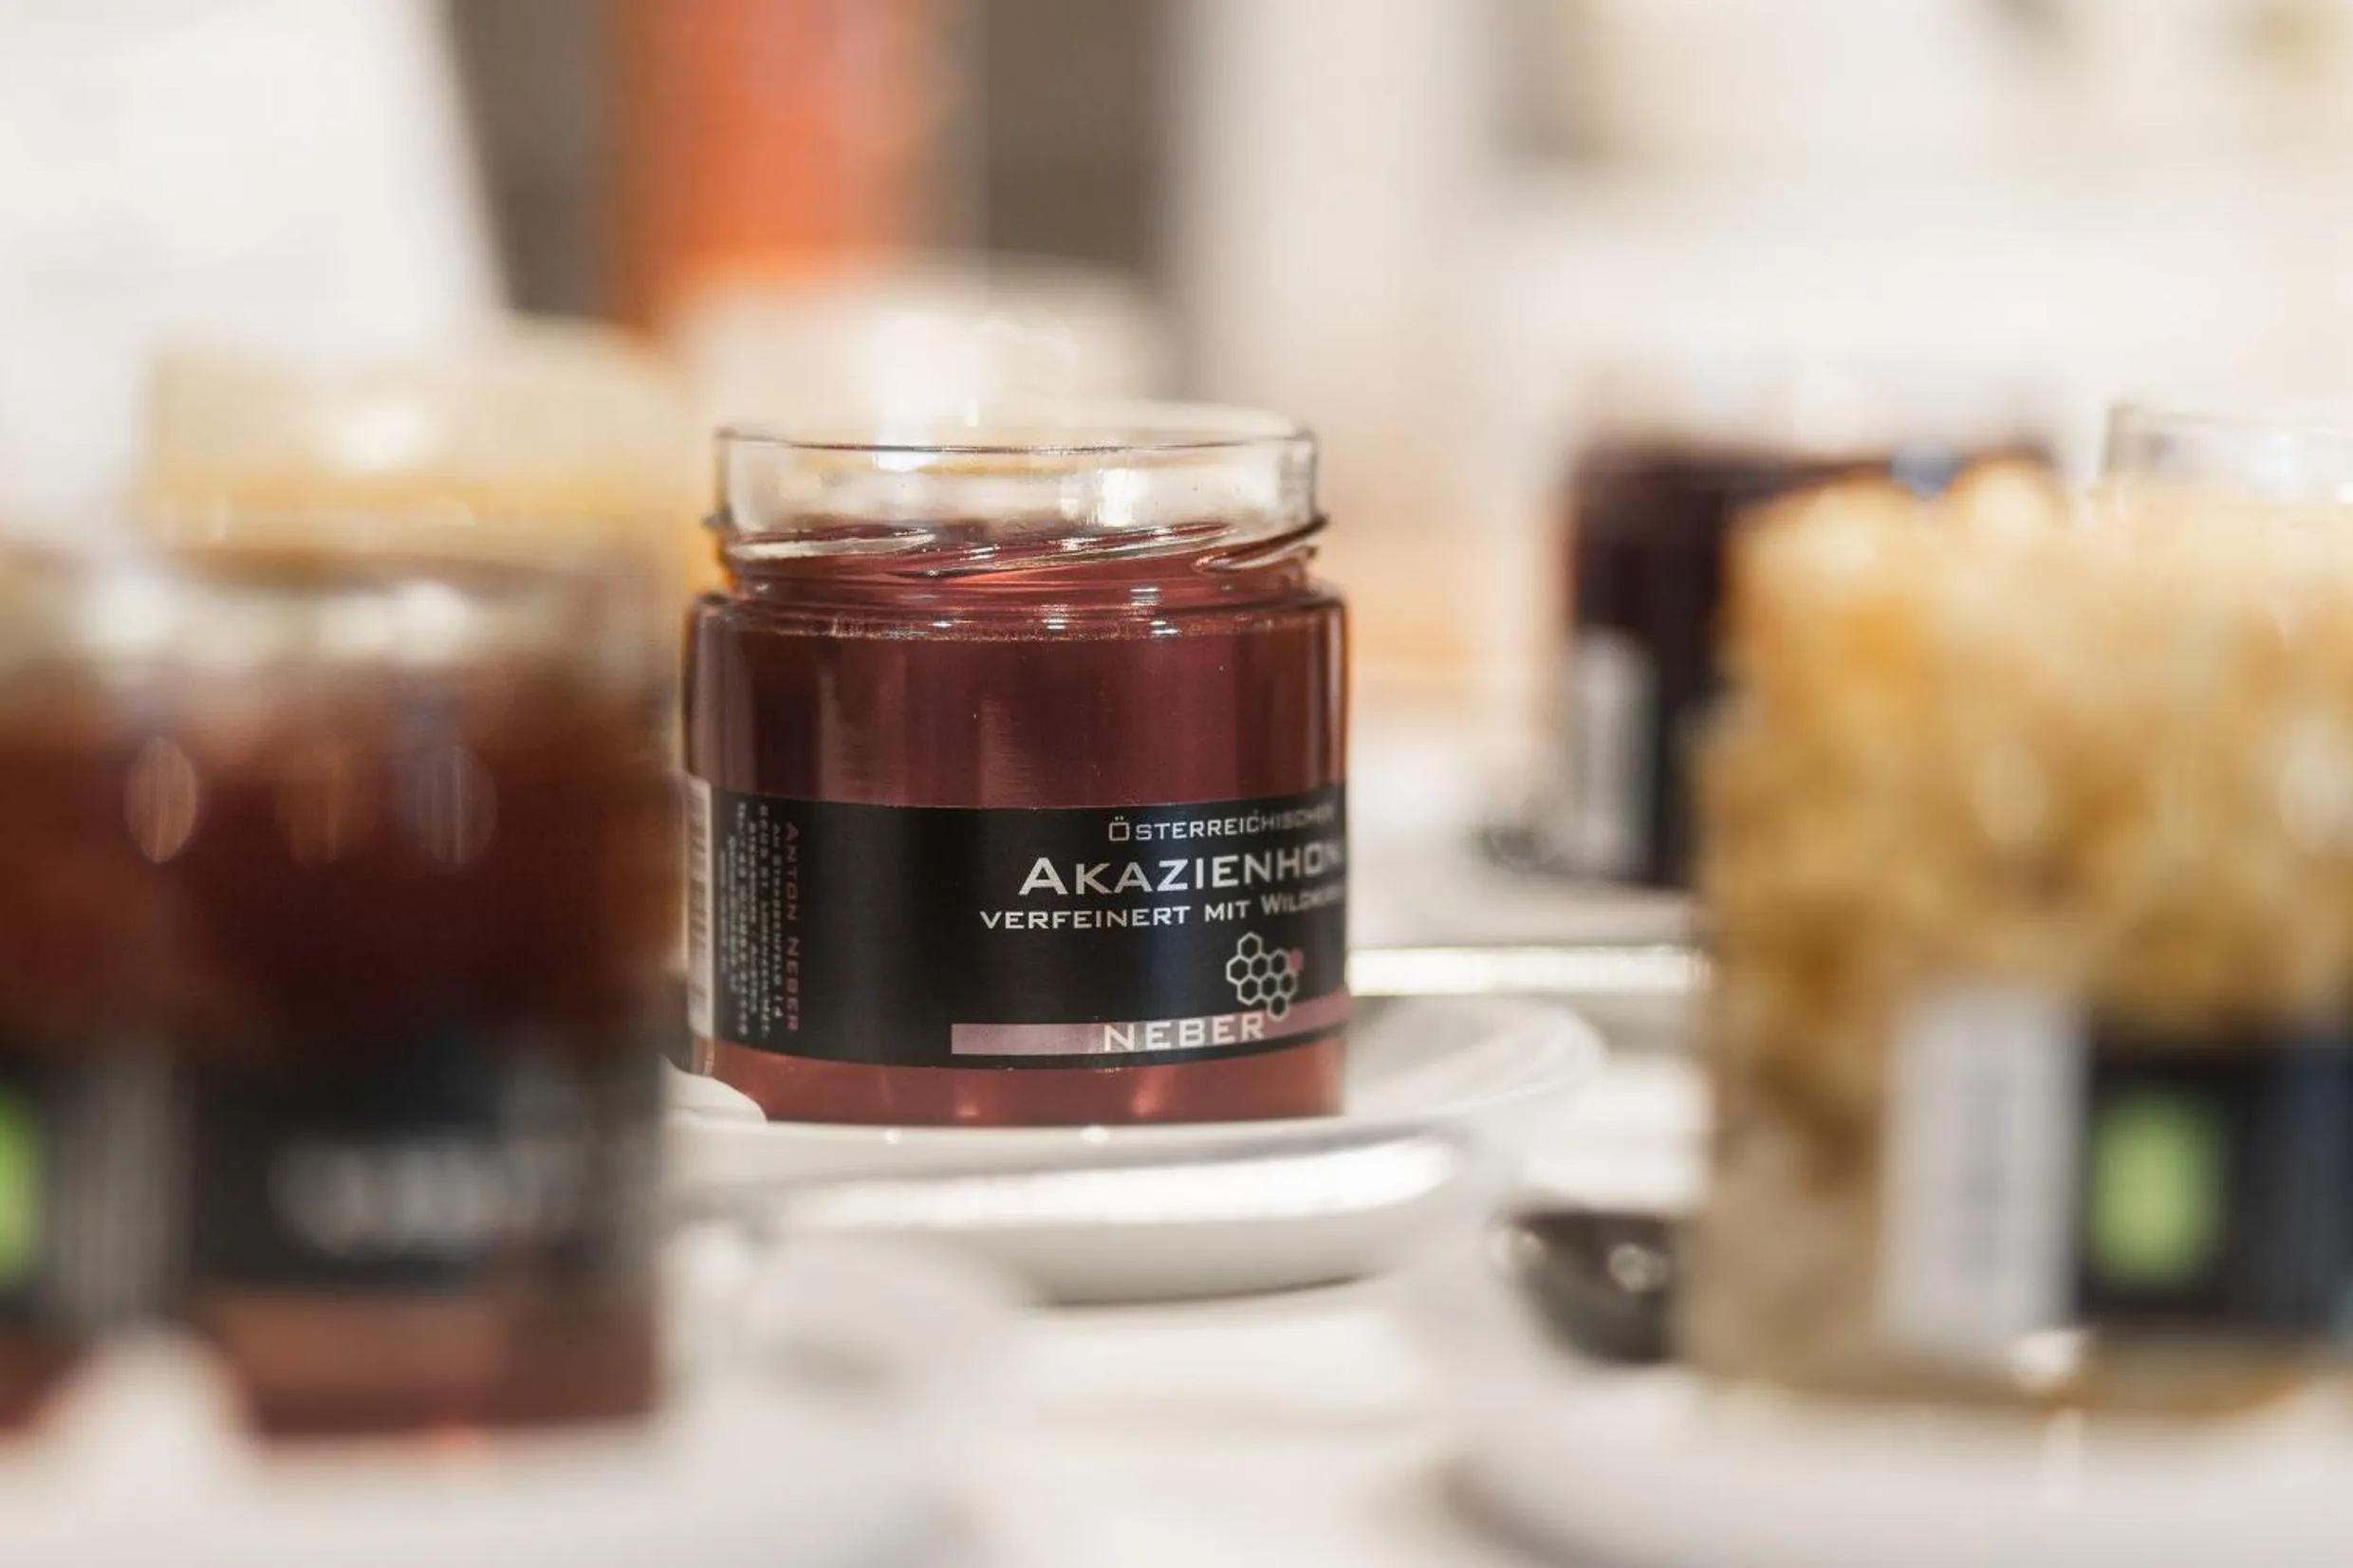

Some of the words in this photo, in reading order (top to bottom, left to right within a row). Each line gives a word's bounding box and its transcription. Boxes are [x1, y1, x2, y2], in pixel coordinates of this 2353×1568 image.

[979, 905, 1192, 930] VERFEINERT
[1204, 900, 1251, 922] MIT
[1102, 1011, 1265, 1053] NEBER
